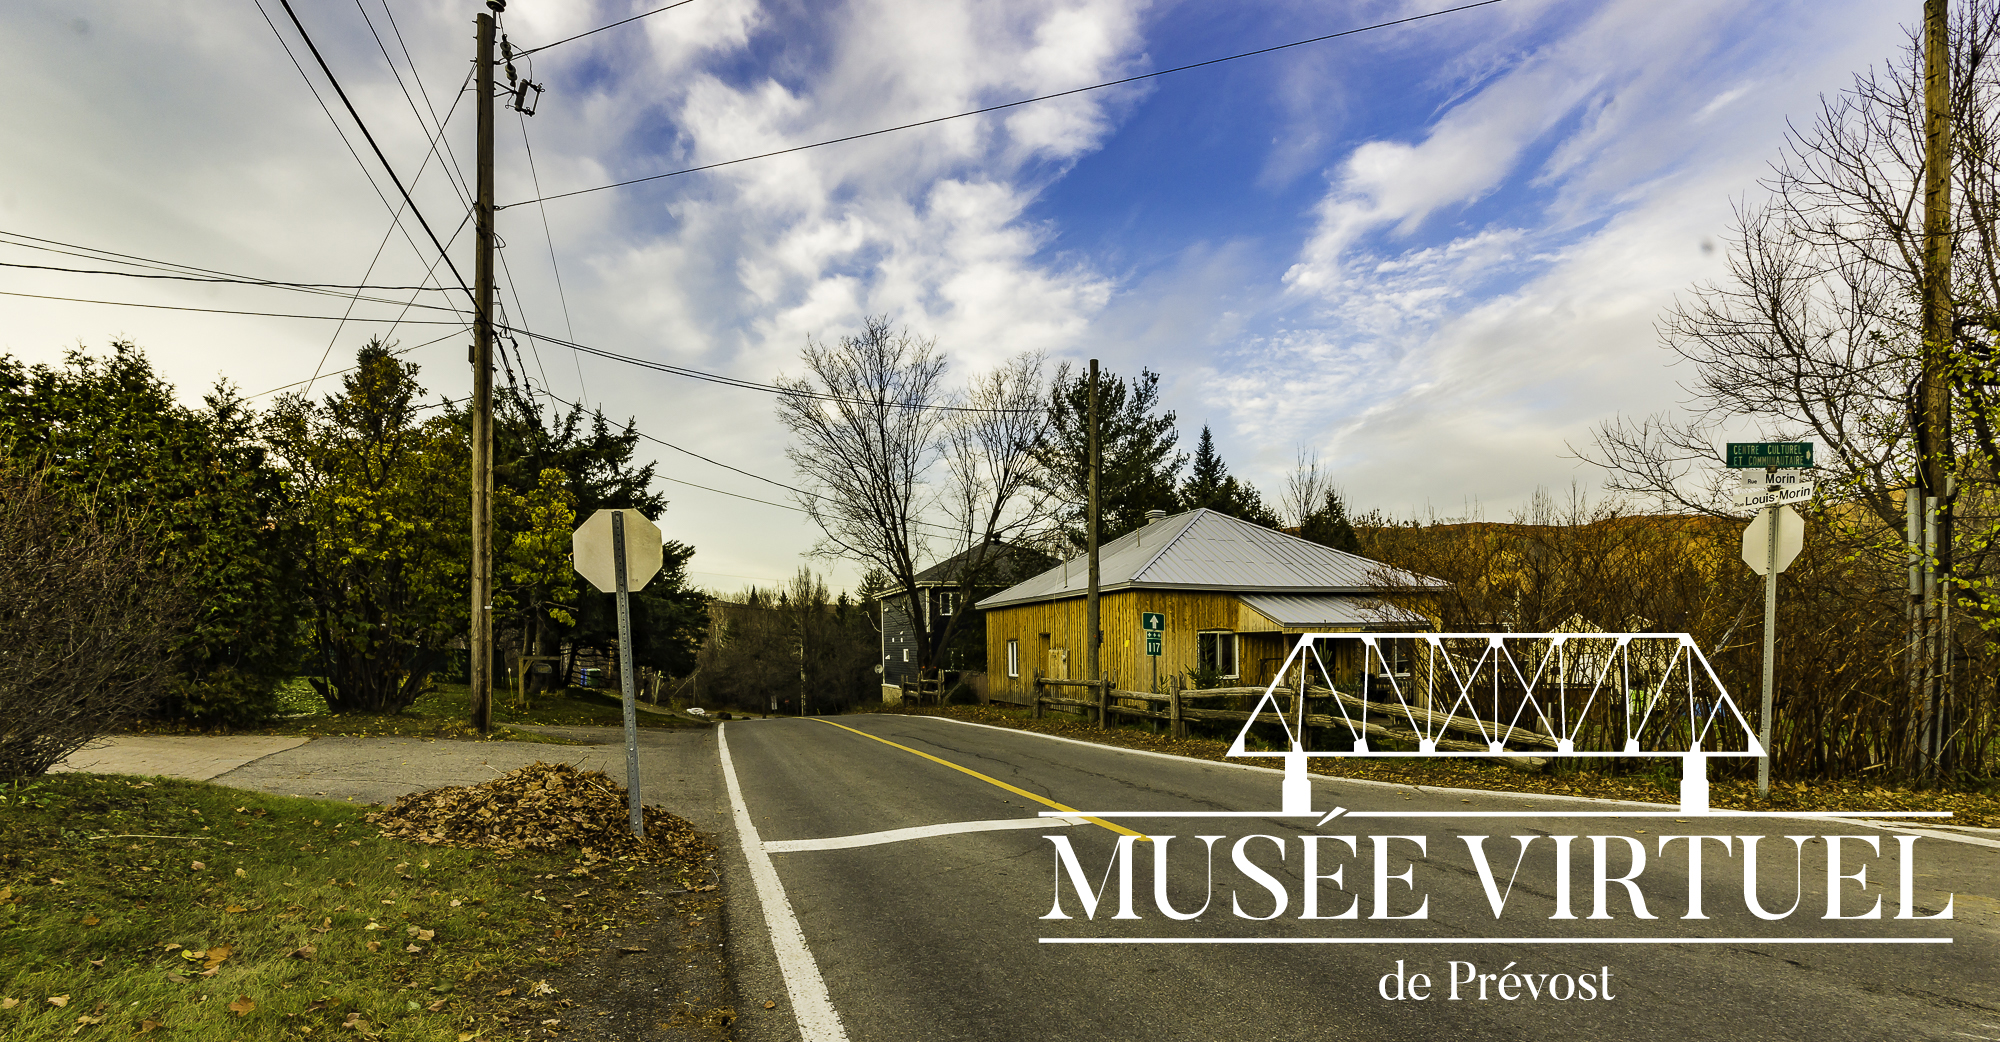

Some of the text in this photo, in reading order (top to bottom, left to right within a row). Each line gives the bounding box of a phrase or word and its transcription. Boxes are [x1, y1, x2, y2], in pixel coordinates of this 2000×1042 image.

[1733, 444, 1802, 455] CENTRE CULTUREL
[1733, 455, 1804, 466] ET COMMUNAUTAIRE
[1765, 473, 1796, 484] Morin
[1745, 486, 1811, 507] Louis-Morin
[1148, 642, 1161, 653] 117
